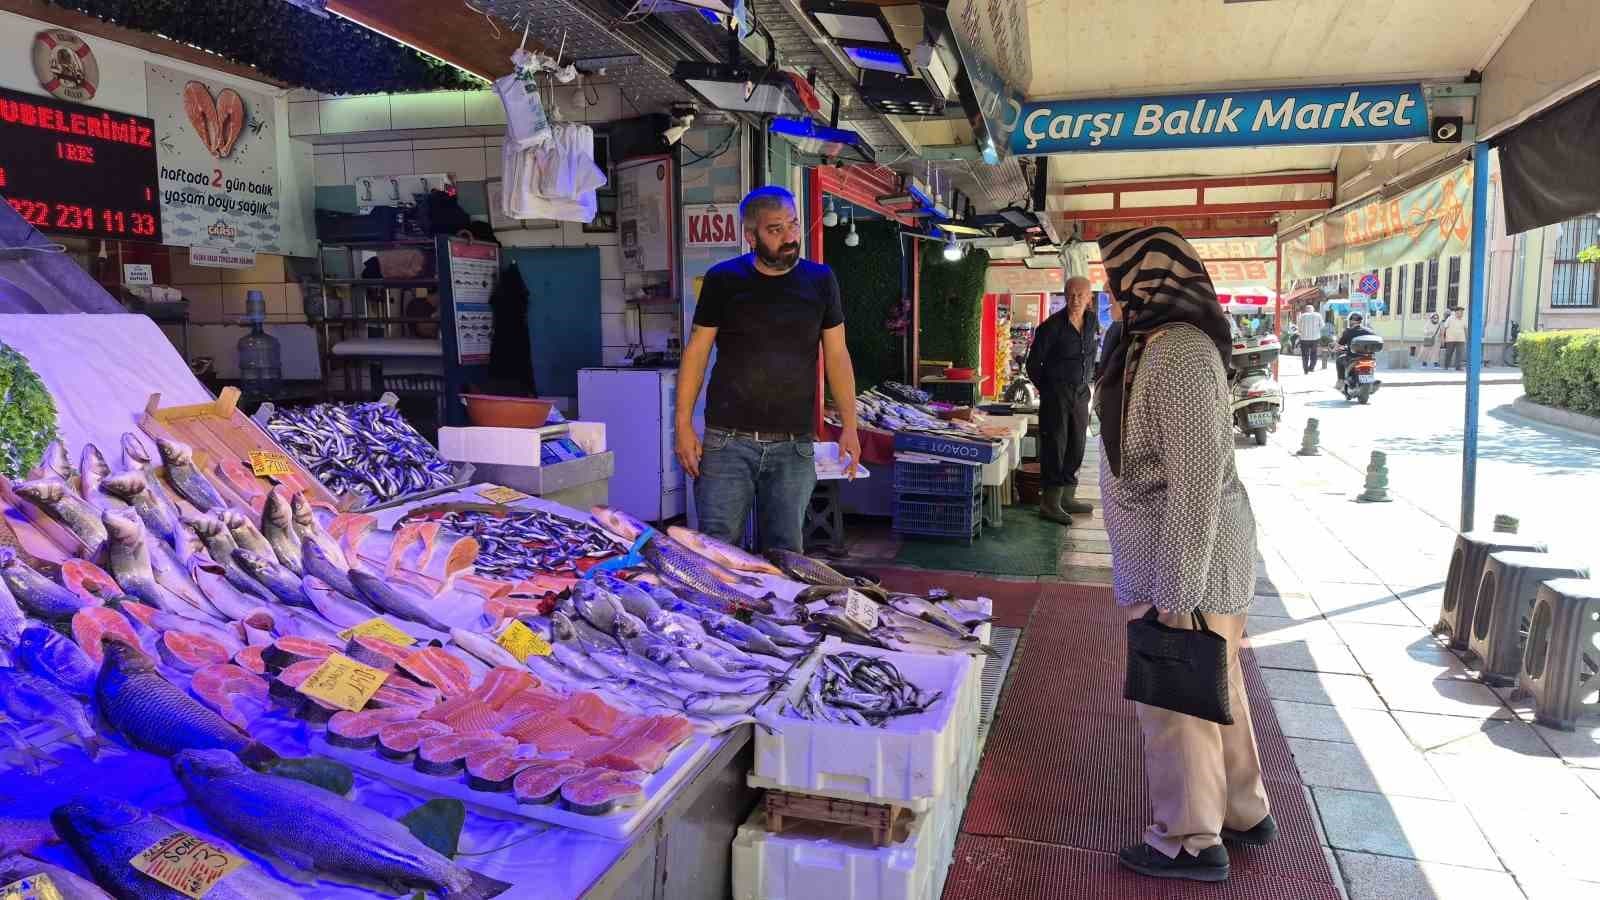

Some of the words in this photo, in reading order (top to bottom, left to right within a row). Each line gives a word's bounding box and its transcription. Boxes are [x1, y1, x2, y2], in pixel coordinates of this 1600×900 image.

[1023, 108, 1125, 149] Çarşı
[1134, 97, 1245, 136] Balık
[1251, 91, 1415, 132] Market
[160, 166, 209, 186] haftada
[211, 168, 223, 188] 2
[225, 176, 246, 193] gün
[248, 178, 273, 197] balık
[164, 189, 205, 205] yaşam
[208, 194, 236, 212] boyu
[55, 205, 94, 230] 231
[103, 208, 126, 232] 11
[130, 212, 156, 235] 33
[688, 213, 737, 242] KASA
